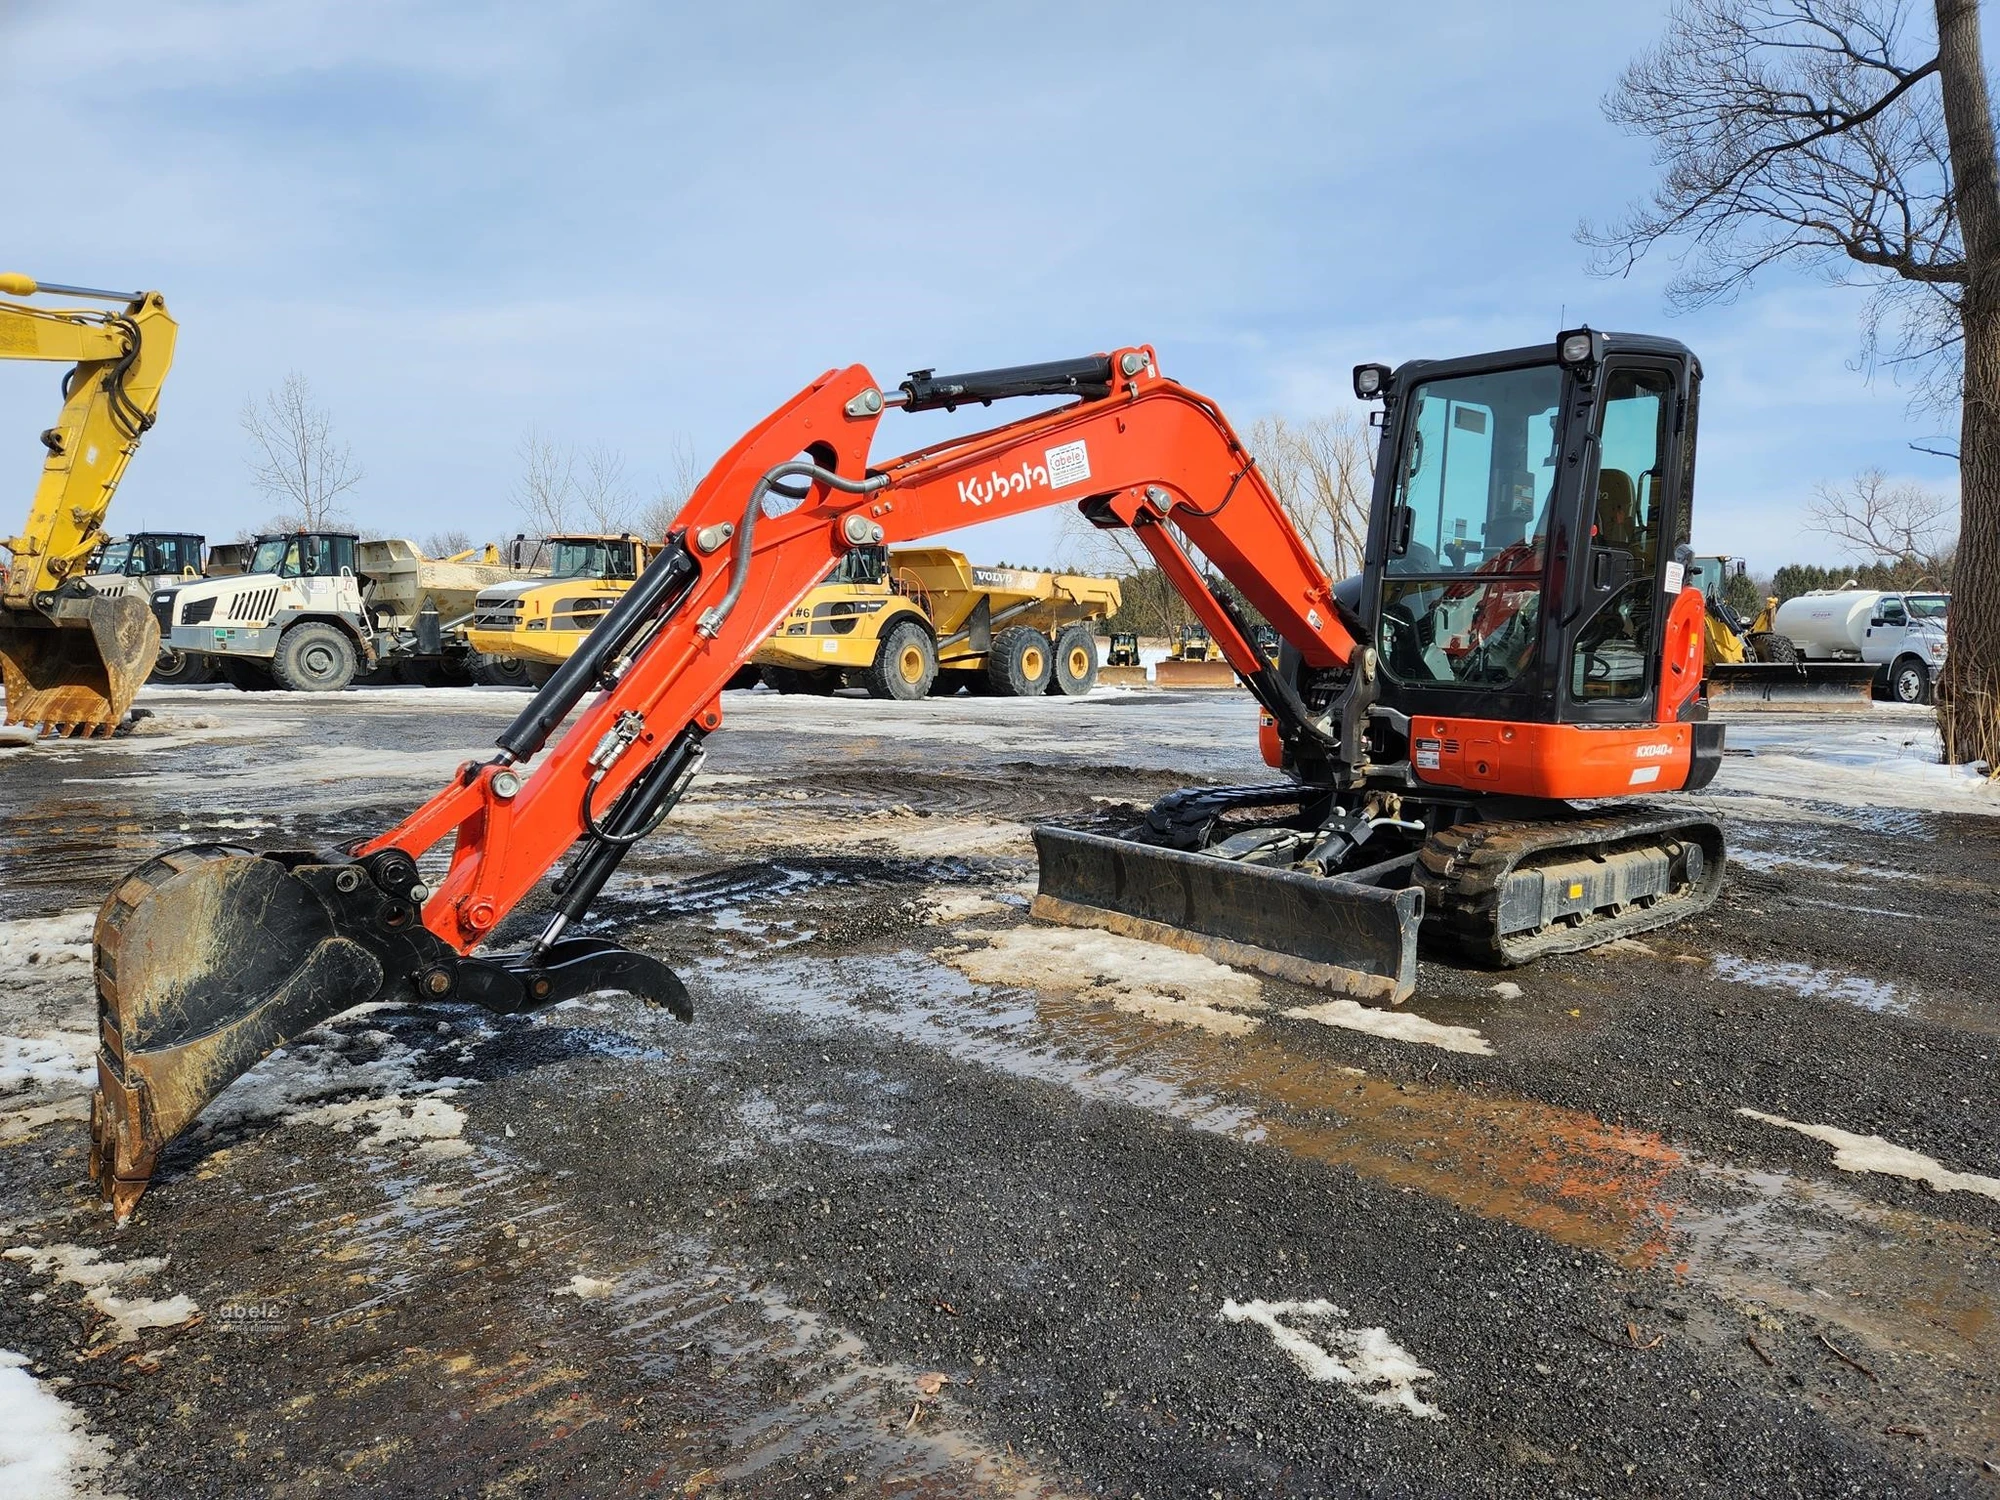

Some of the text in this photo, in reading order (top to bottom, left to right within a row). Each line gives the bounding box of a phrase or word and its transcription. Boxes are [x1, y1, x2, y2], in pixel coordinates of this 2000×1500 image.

[1054, 452, 1080, 467] abele
[957, 461, 1048, 506] Kubota
[976, 571, 1013, 583] VOLVO
